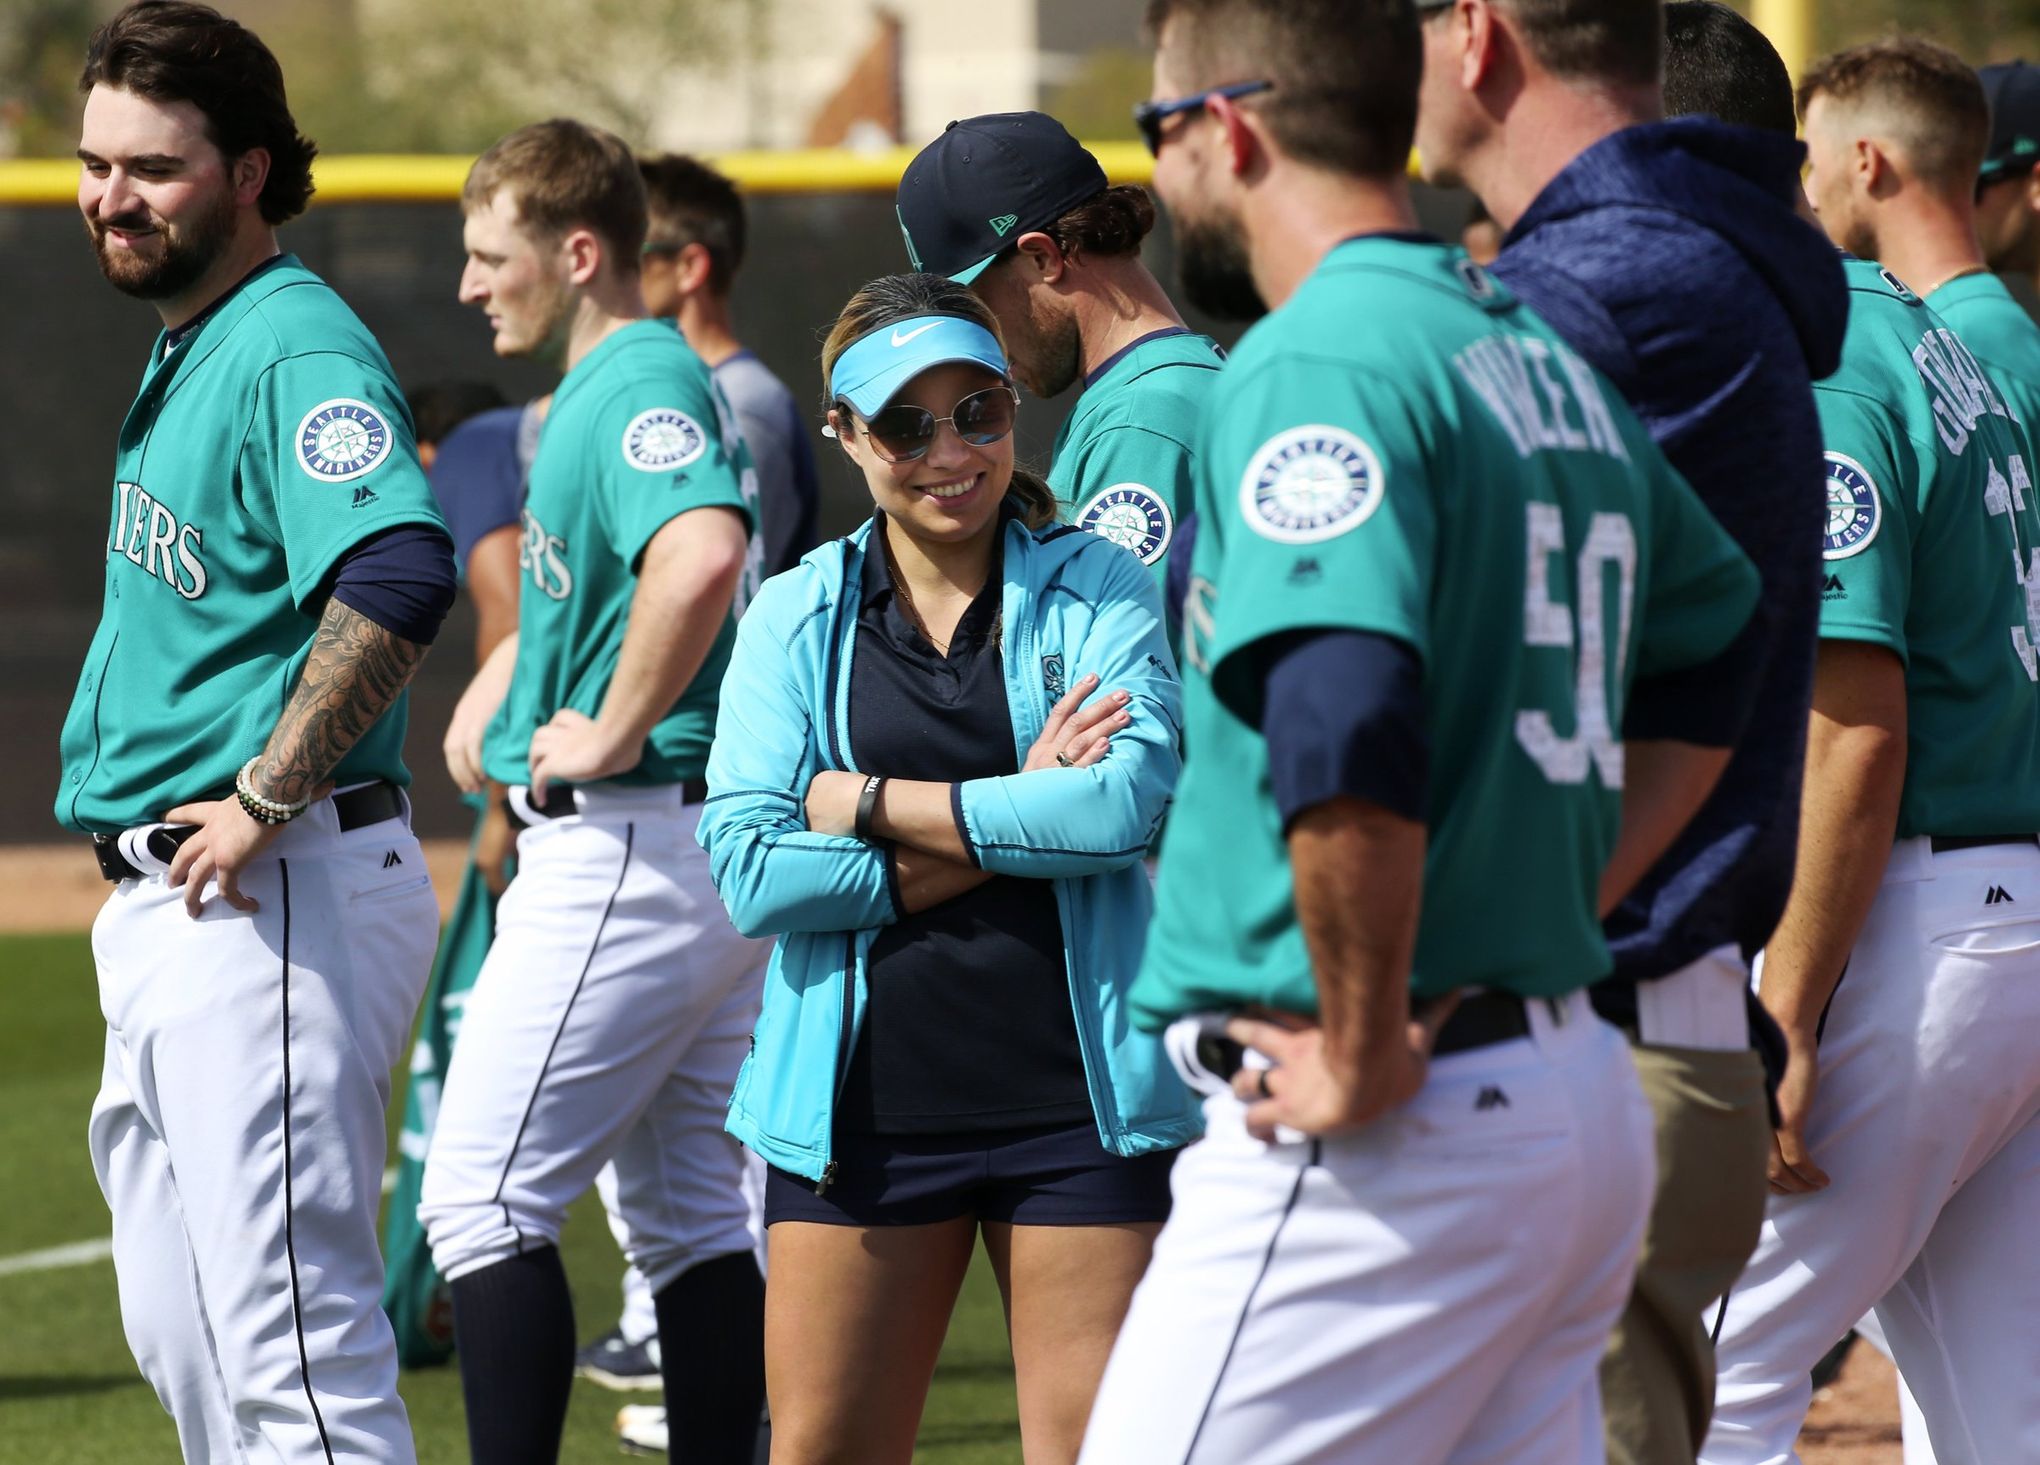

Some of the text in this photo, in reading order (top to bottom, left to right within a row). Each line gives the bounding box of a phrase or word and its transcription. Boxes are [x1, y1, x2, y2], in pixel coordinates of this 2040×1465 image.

[304, 407, 373, 447] SEATTLE
[313, 435, 384, 475] MARINERS
[1093, 491, 1163, 528] SEATTLE
[1514, 500, 1638, 791] 50
